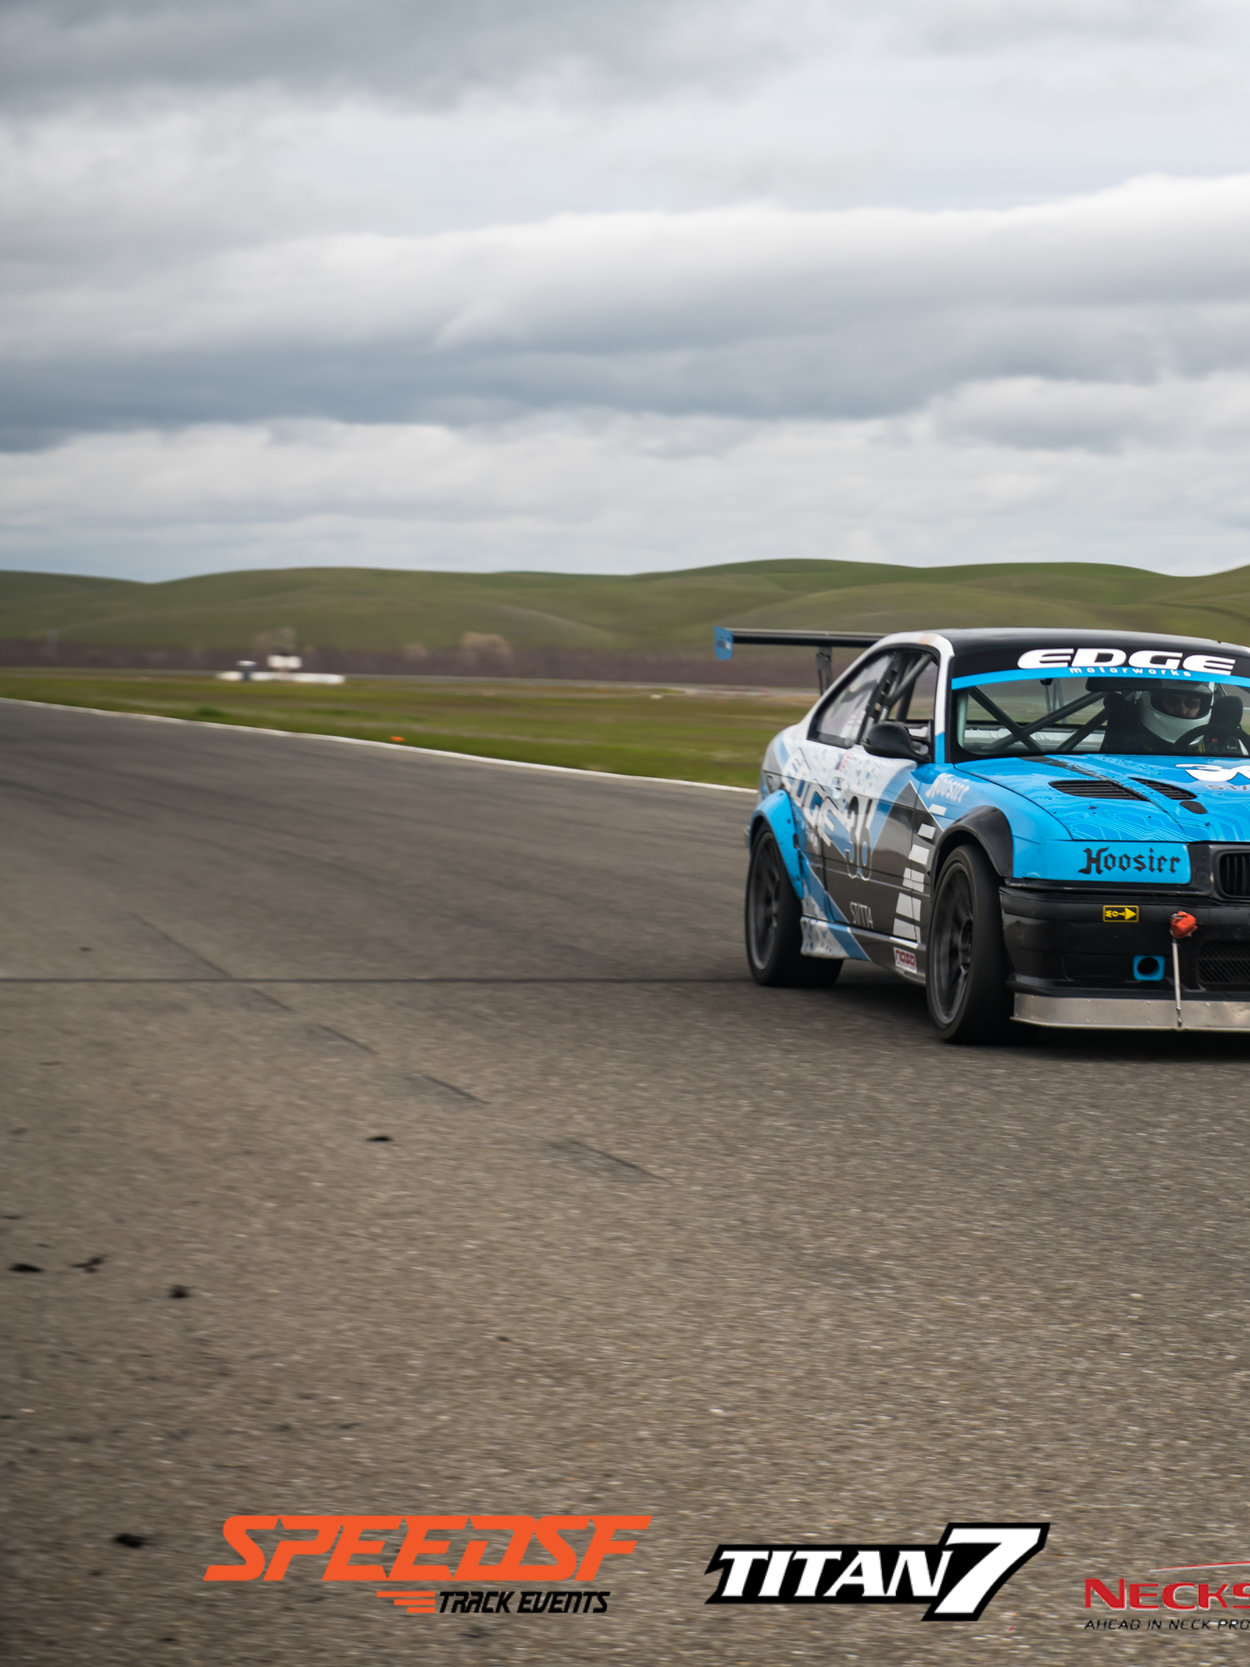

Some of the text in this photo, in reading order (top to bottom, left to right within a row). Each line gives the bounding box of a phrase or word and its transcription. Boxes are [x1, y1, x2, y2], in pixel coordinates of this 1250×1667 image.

[1017, 648, 1236, 675] EDGE
[1069, 666, 1192, 677] motorworks
[844, 795, 872, 881] 36
[1078, 846, 1181, 875] Hoosier
